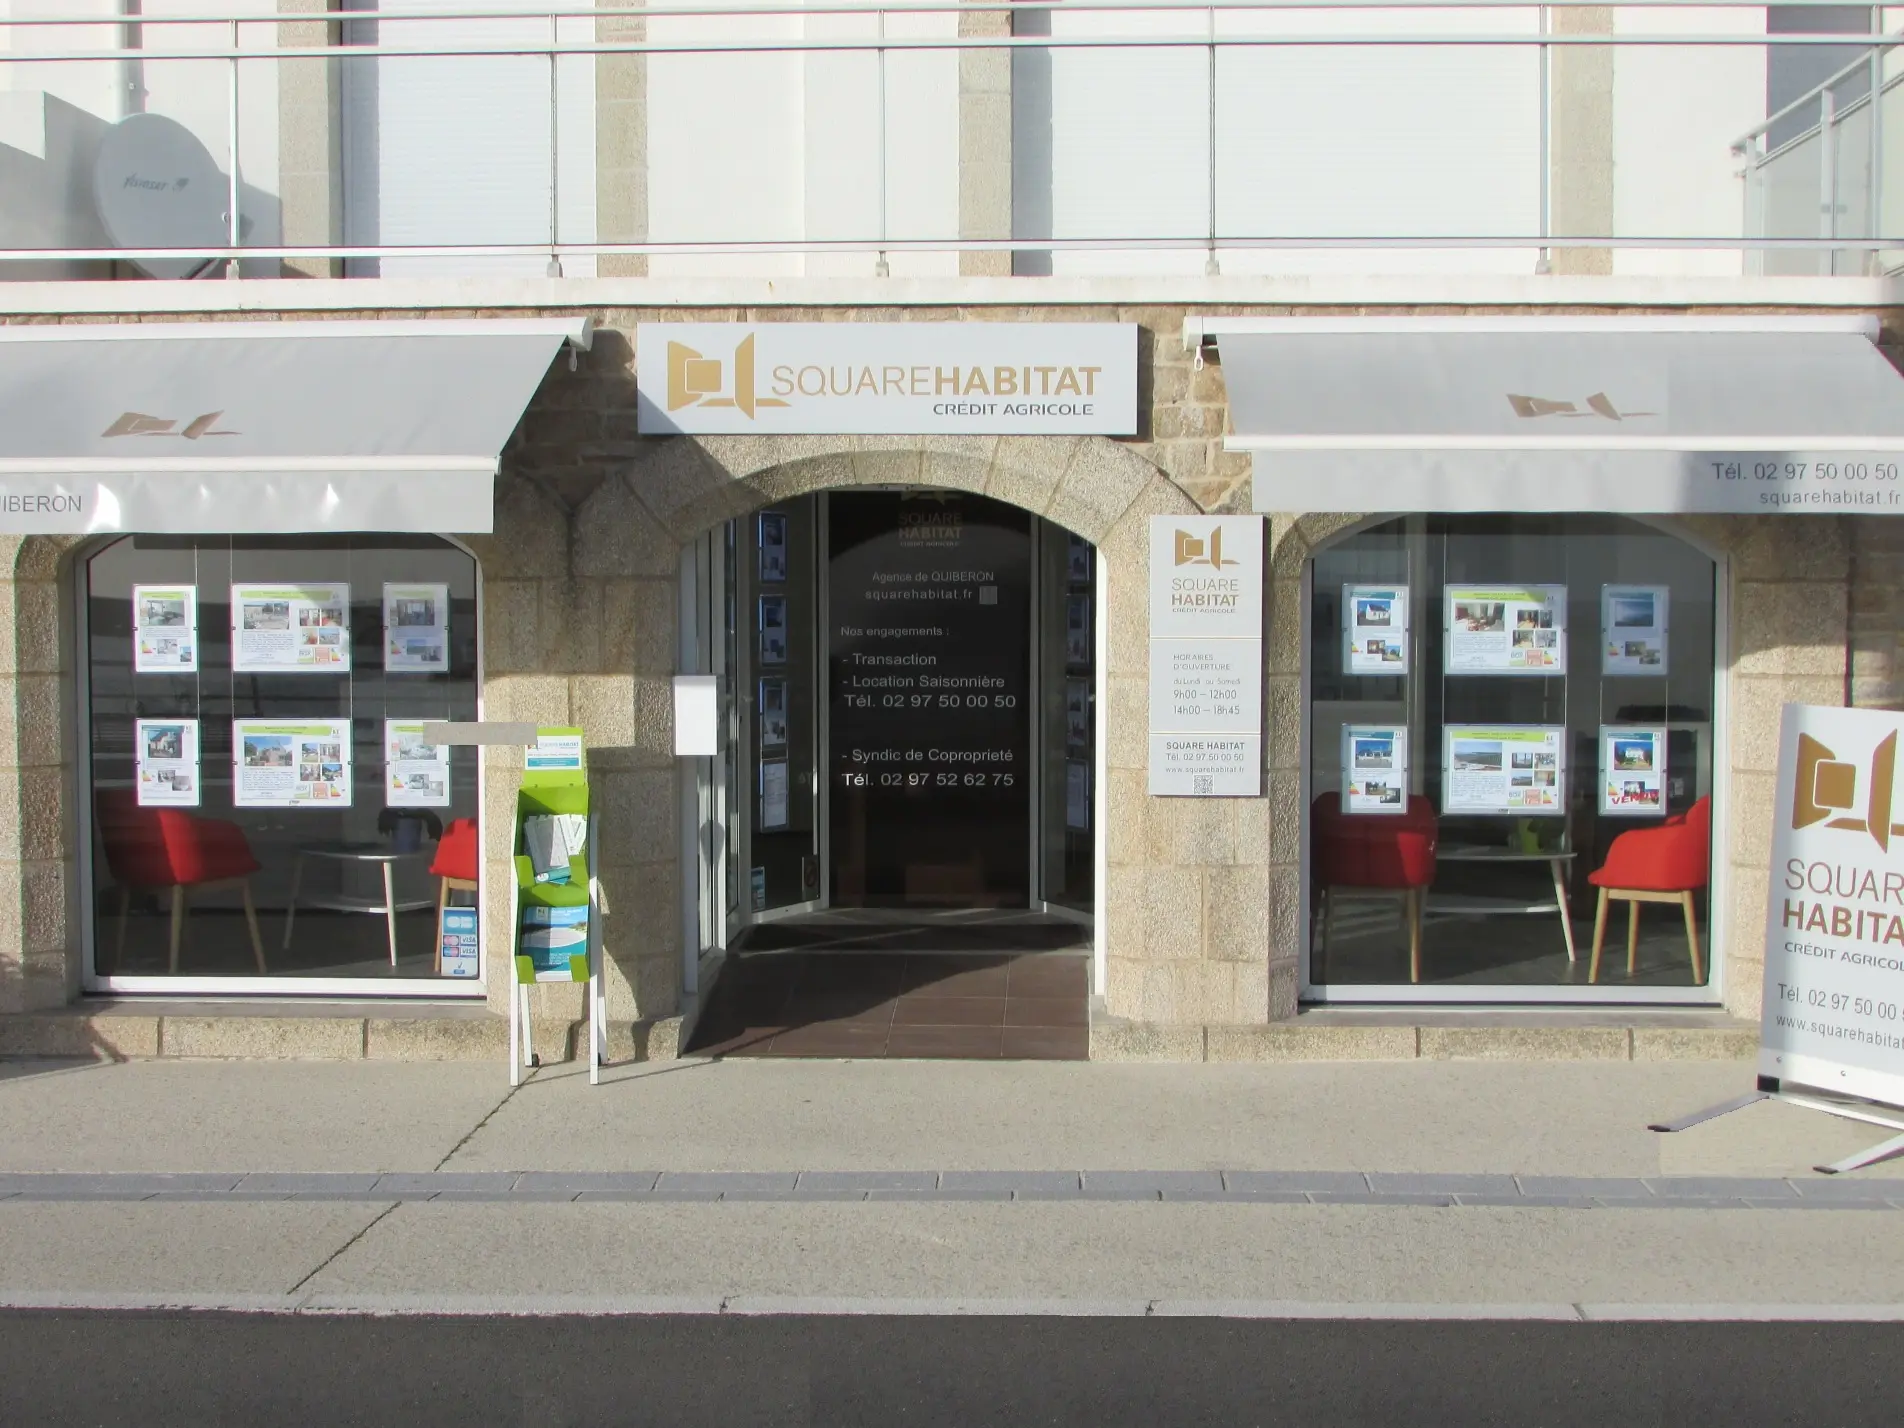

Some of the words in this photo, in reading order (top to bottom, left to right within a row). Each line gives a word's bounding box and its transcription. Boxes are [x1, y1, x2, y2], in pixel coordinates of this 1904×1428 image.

[933, 401, 997, 416] CRÉDIT
[1003, 403, 1094, 416] AGRICOLE
[1712, 463, 1747, 480] Tél.
[1755, 463, 1777, 480] 02
[1785, 463, 1807, 480] 97
[1815, 463, 1837, 480] 50
[1844, 463, 1867, 480] 00
[1875, 463, 1898, 480] 50
[0, 495, 81, 512] IBERON
[1760, 489, 1900, 507] squarehabitat.fr
[898, 512, 963, 526] SQUARE
[898, 527, 963, 539] HABITAT
[872, 572, 912, 584] Agence
[915, 572, 928, 582] de
[931, 571, 994, 583] QUIBERON
[1172, 578, 1239, 591] SQUARE
[865, 589, 973, 601] squarehabitat.fr
[1171, 594, 1239, 606] HABITAT
[840, 626, 863, 636] Nos
[866, 627, 943, 638] engagements
[853, 653, 937, 665] Transaction
[853, 676, 914, 687] Location
[919, 675, 1005, 687] Saisonnière
[844, 694, 876, 707] Tél.
[883, 695, 904, 707] 02
[910, 695, 932, 707] 97
[938, 695, 960, 707] 50
[966, 695, 988, 707] 00
[994, 695, 1016, 707] 50
[1173, 689, 1197, 699] 9h00
[1209, 689, 1237, 699] 12h00
[1174, 705, 1200, 715] 14h00
[1214, 705, 1240, 715] 18h45
[1166, 742, 1204, 750] SQUARE
[1207, 742, 1245, 750] HABITAT
[852, 749, 901, 763] Syndic
[905, 749, 923, 761] de
[1166, 753, 1180, 761] Tél.
[1183, 753, 1193, 761] 02
[1196, 753, 1206, 761] 97
[1208, 753, 1219, 761] 50
[1221, 753, 1231, 761] 00
[1233, 753, 1244, 761] 50
[842, 773, 874, 786] Tél.
[881, 773, 902, 786] 02
[908, 773, 930, 786] 97
[936, 773, 958, 786] 52
[964, 773, 986, 786] 62
[992, 773, 1014, 786] 75
[1784, 942, 1836, 960] CRÉDIT
[1778, 983, 1803, 1003] Tél.
[1808, 989, 1826, 1008] 02
[1831, 993, 1849, 1011] 97
[1854, 998, 1873, 1016] 50
[1877, 1002, 1896, 1020] 00
